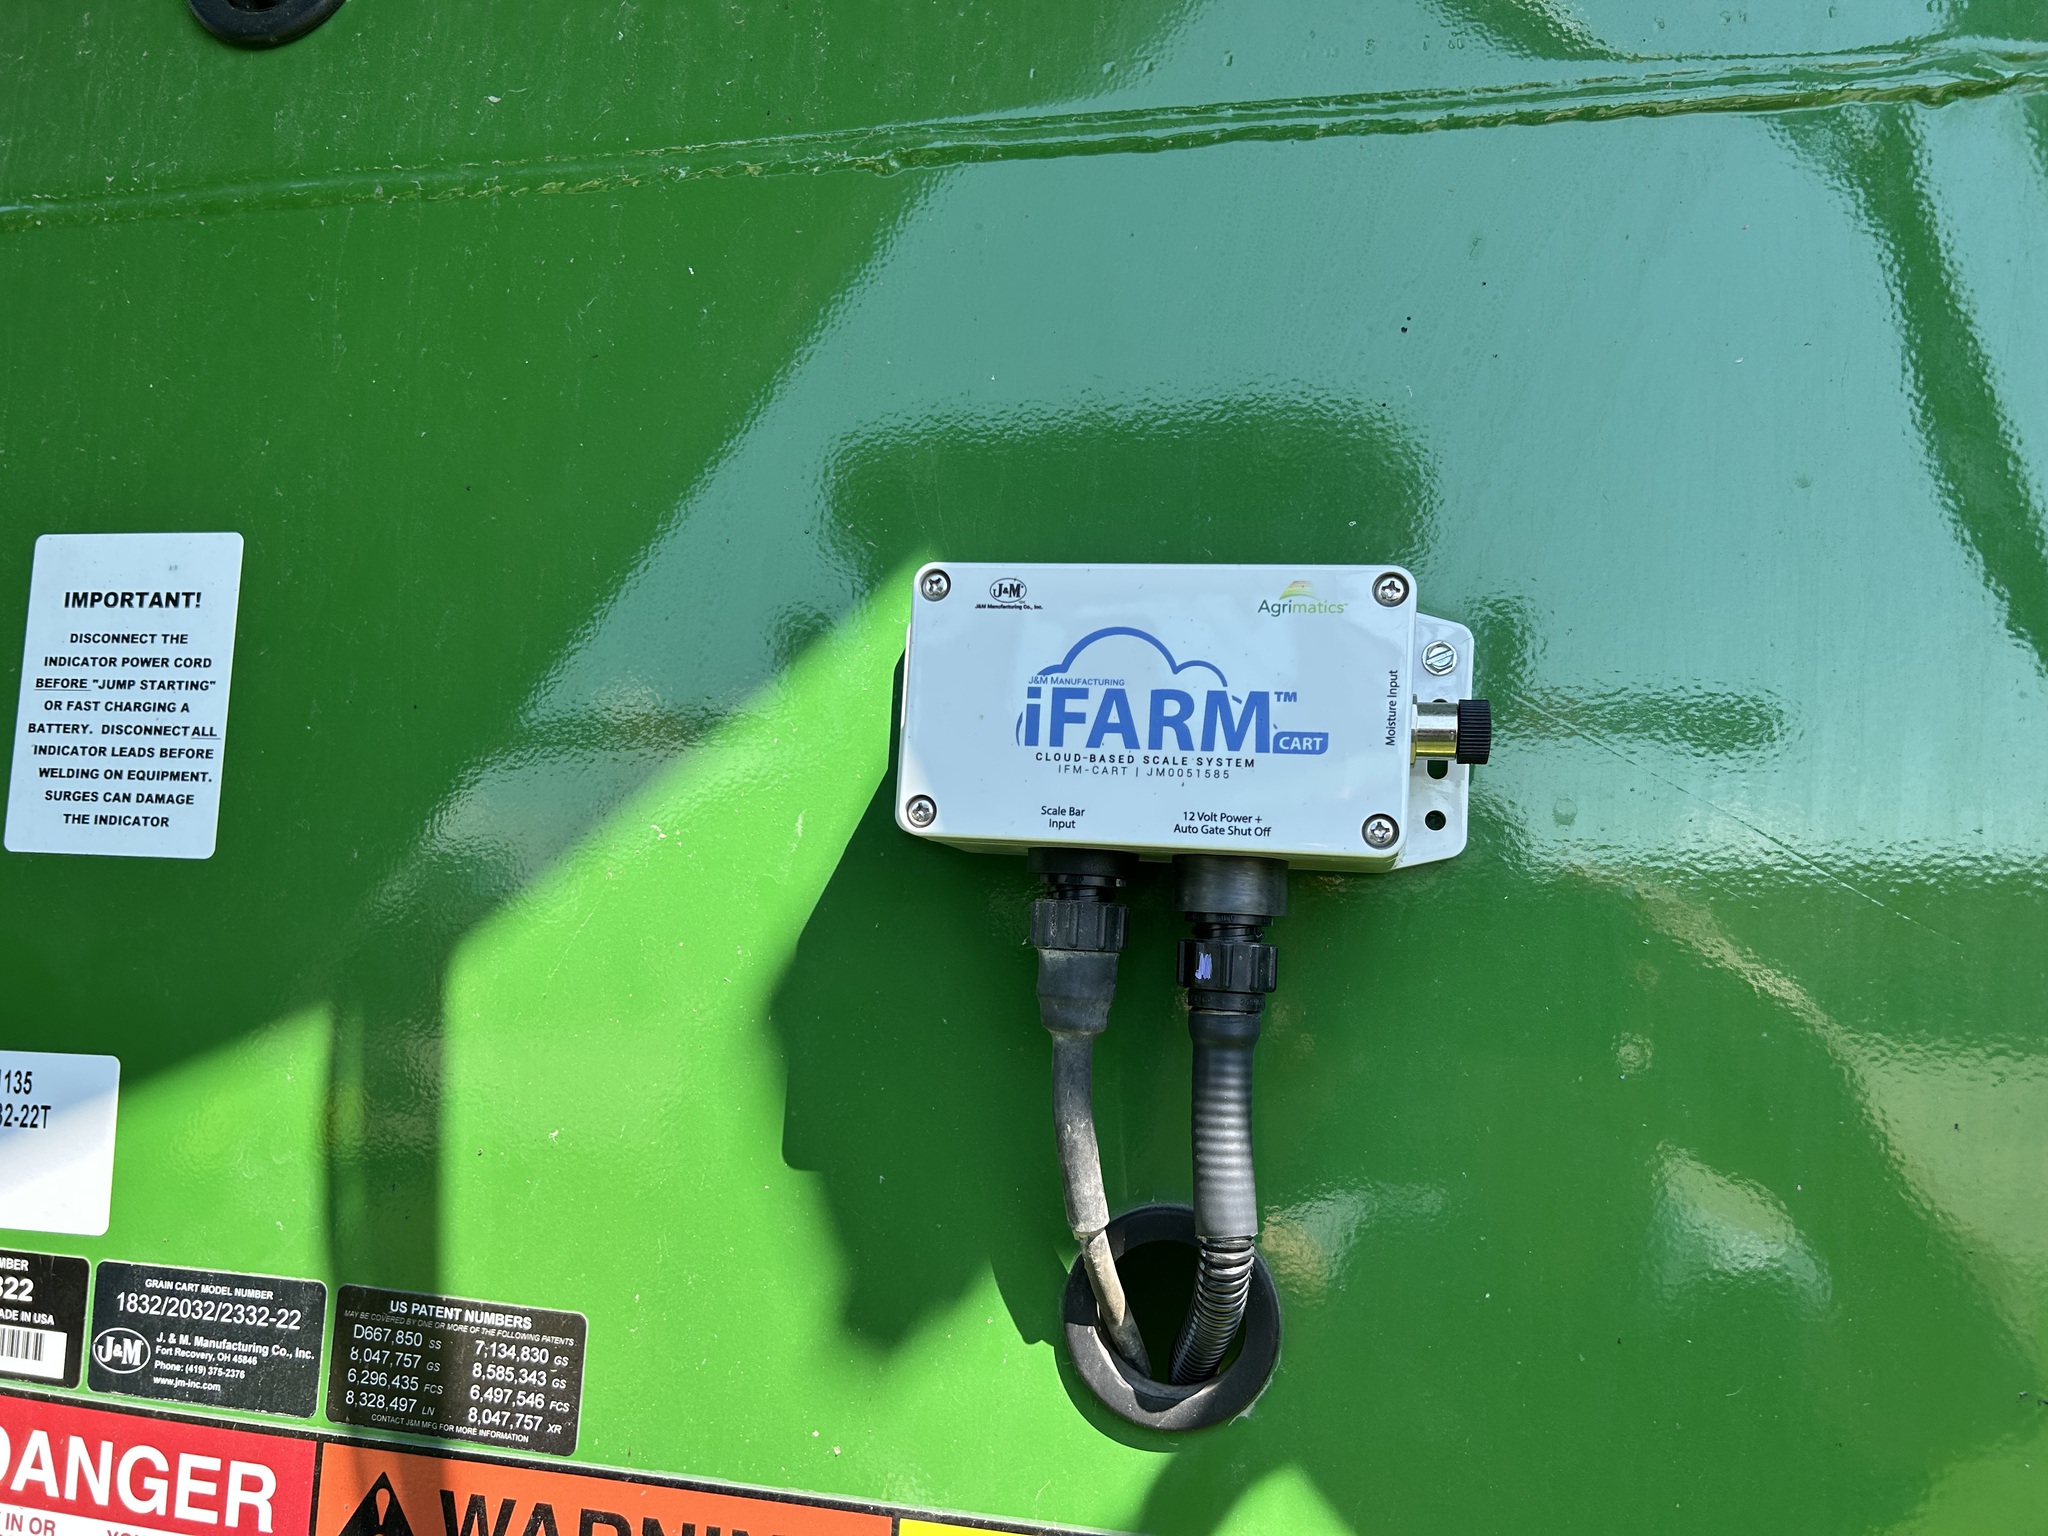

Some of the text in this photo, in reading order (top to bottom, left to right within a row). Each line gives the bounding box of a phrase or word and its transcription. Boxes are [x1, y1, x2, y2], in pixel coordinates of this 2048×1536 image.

[64, 591, 202, 608] IMPORTANT!
[993, 583, 1021, 598] J&M
[1257, 599, 1345, 617] Agrimatics
[70, 633, 188, 645] DISCONNECT THE
[44, 656, 212, 668] INDICATOR POWER CORD
[35, 678, 216, 691] BEFORE "JUMP STARTING"
[1028, 675, 1125, 687] J&M MANUFACTURING
[44, 700, 190, 713] OR FAST CHARGING A
[1385, 670, 1400, 746] Moisture Input
[1024, 686, 1270, 753] iFARM
[28, 723, 218, 737] BATTERY. DISCONNECT ALL
[33, 745, 214, 759] INDICATOR LEADS BEFORE
[1279, 736, 1324, 751] CART
[1035, 752, 1255, 768] CLOUD-BASED SCALE SYSTEM
[38, 767, 213, 782] WELDING ON EQUIPMENT.
[1058, 765, 1128, 776] IFM-CART
[1147, 768, 1230, 779] JM0051585
[45, 790, 194, 805] SURGES CAN DAMAGE
[63, 814, 170, 827] THE INDICATOR
[1041, 805, 1085, 817] Scale Bar
[1183, 811, 1195, 821] 12
[1197, 812, 1218, 822] Volt
[1220, 813, 1253, 824] Power
[1049, 819, 1076, 830] Input
[1173, 825, 1272, 837] Auto Gate Shut Off
[0, 1069, 32, 1095] 135
[0, 1103, 52, 1129] 2-22T
[0, 1276, 34, 1302] 22
[145, 1278, 274, 1300] GRAIN CART MODEL NUMBER
[20, 1311, 31, 1322] IN
[33, 1313, 55, 1326] USA
[116, 1291, 302, 1331] 1832/2032/2332-22
[390, 1300, 532, 1329] US PATENT NUMBERS
[344, 1309, 574, 1346] MAY BE COVERED BY ONE OR MORE OF THE FOLLOWING PATENTS
[353, 1324, 442, 1349] D667,850 SS
[97, 1336, 144, 1366] J&M
[155, 1345, 258, 1365] Fort Recovery, OH 45846
[156, 1332, 315, 1360] J. & M. Manufacturing Co., Inc.
[475, 1339, 569, 1367] 7,134,830 GS
[154, 1360, 245, 1380] Phone: (419) 375-2376
[350, 1348, 441, 1372] 8,047,757 GS
[153, 1375, 221, 1392] www.jm-inc.com
[347, 1368, 444, 1395] 6,296,435 FCS
[472, 1362, 567, 1389] 8,585,343 GS
[345, 1390, 435, 1416] 8,328,497 LN
[470, 1384, 570, 1412] 6,497,546 FCS
[371, 1413, 529, 1443] CONTACT J&M MFG FOR MORE INFORMATION
[468, 1407, 563, 1434] 8,047,757 XR
[0, 1425, 277, 1534] ANGER
[5, 1512, 24, 1532] IN
